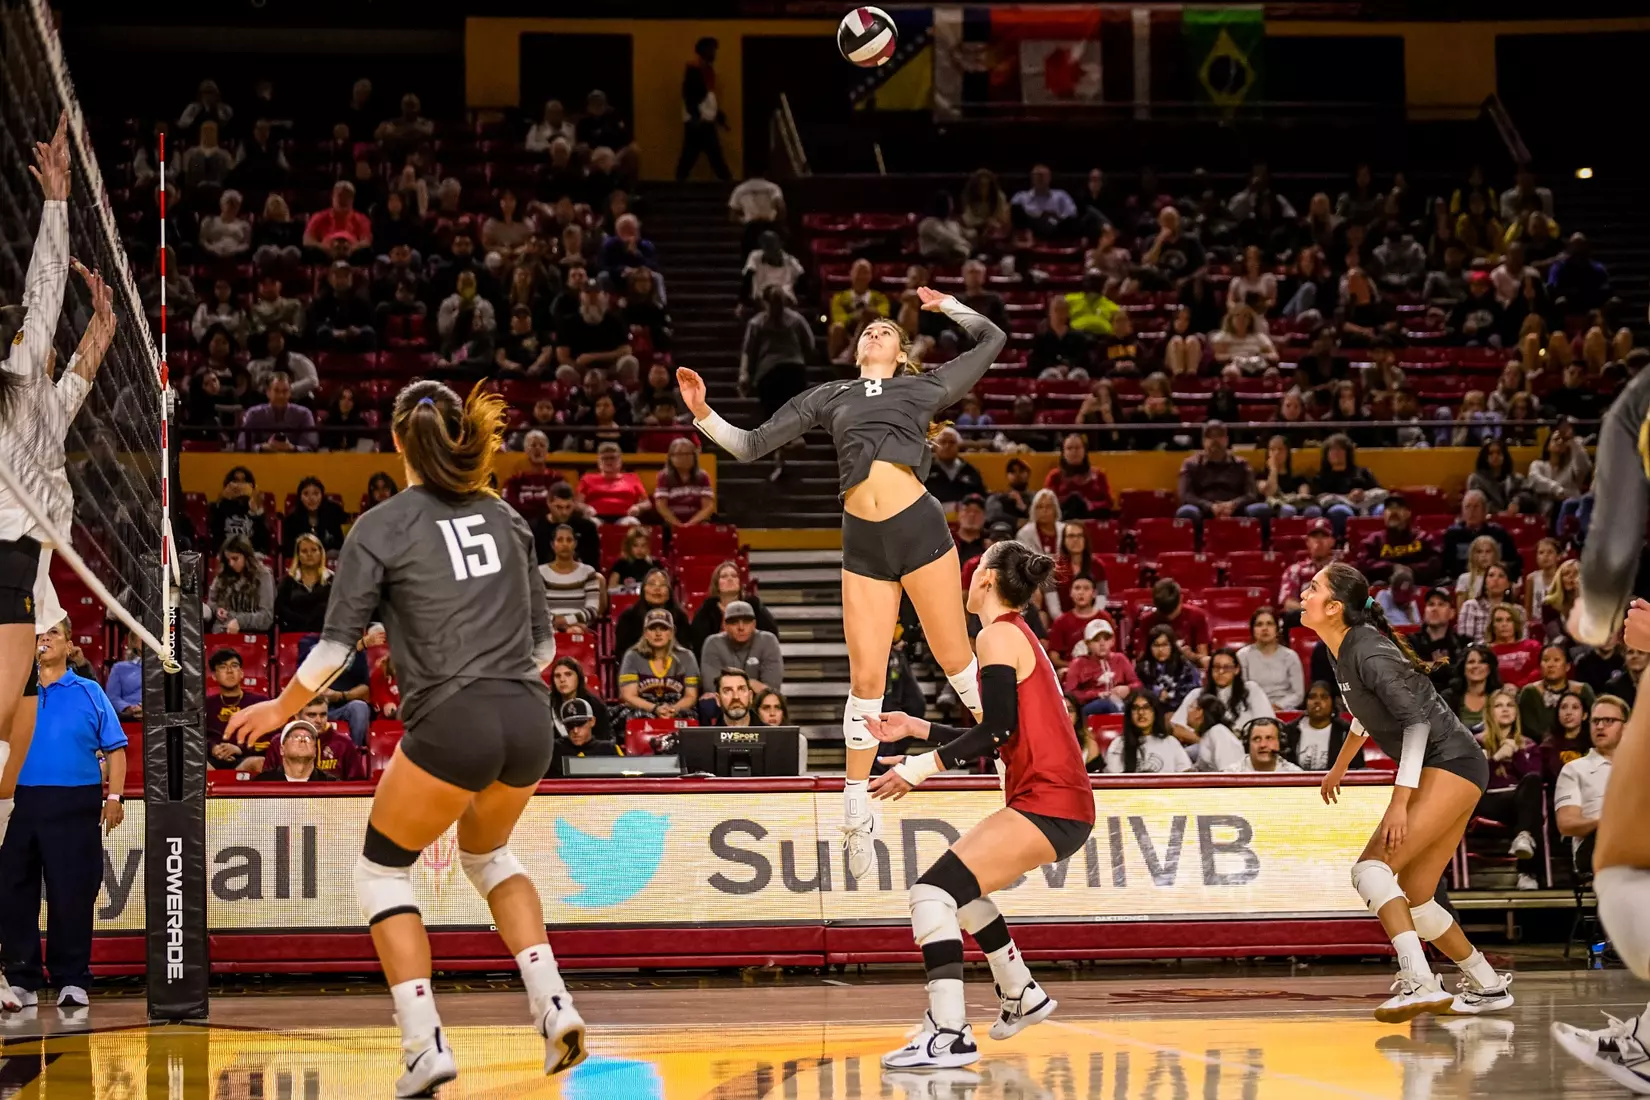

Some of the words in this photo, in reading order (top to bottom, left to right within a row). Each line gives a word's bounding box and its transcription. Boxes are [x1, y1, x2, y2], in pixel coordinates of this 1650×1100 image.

[864, 378, 882, 397] 8
[436, 514, 501, 581] 15
[707, 815, 1260, 895] SunDvilVB
